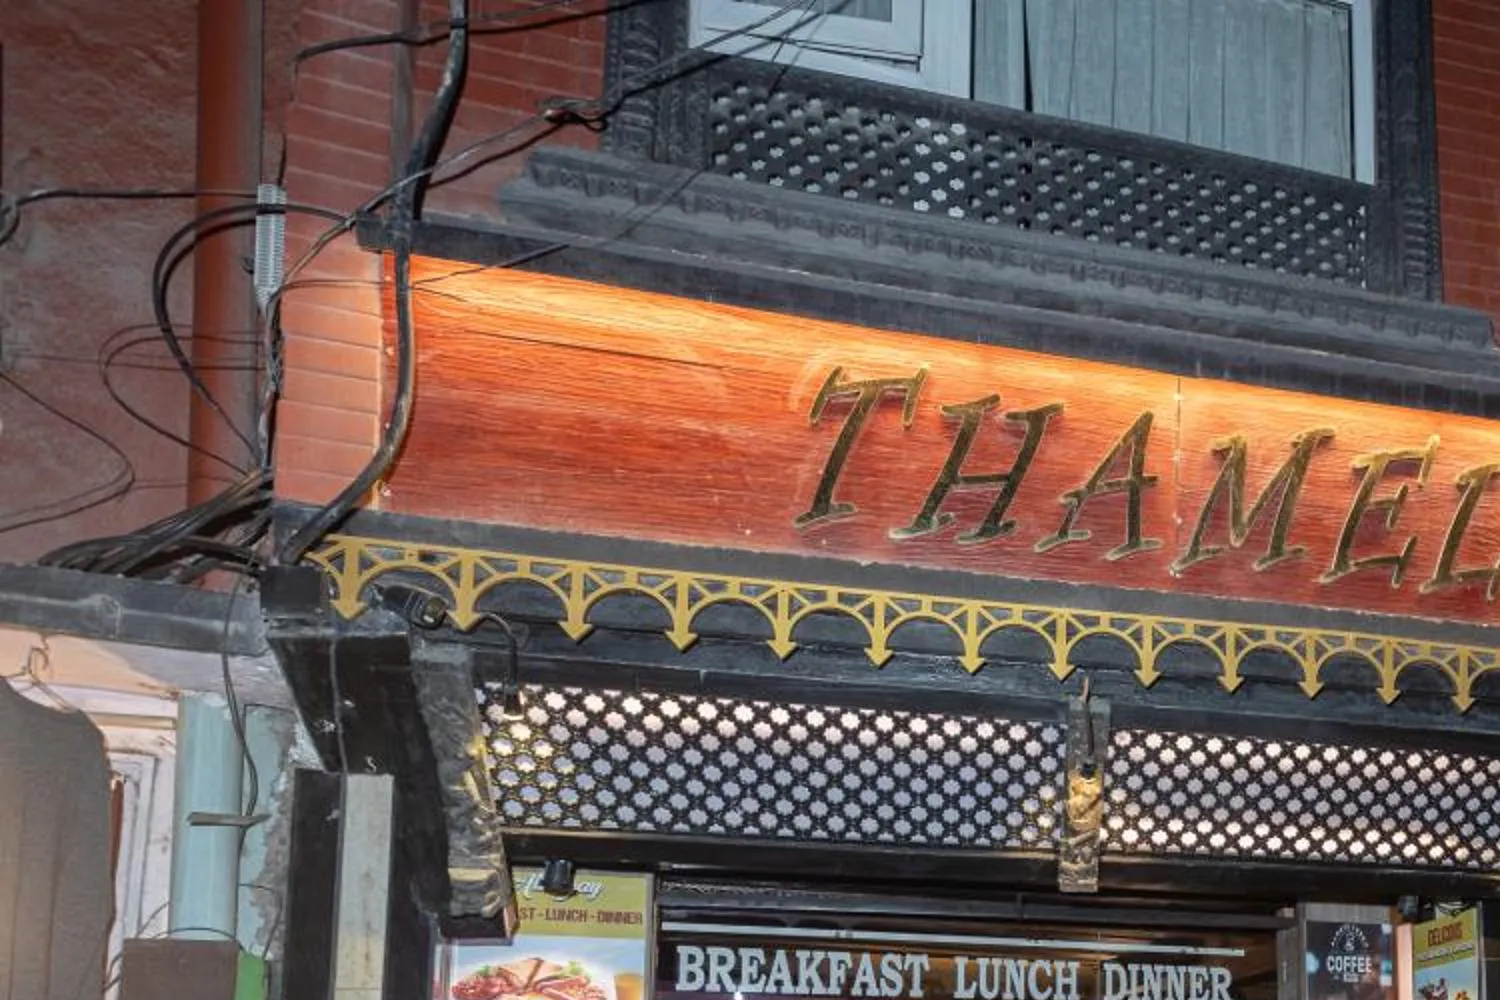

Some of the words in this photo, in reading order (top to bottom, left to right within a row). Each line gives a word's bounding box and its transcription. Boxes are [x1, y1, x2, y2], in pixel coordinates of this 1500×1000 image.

[545, 908, 588, 922] LUNCH
[675, 945, 928, 998] BREAKFAST
[1326, 955, 1373, 973] COFFEE
